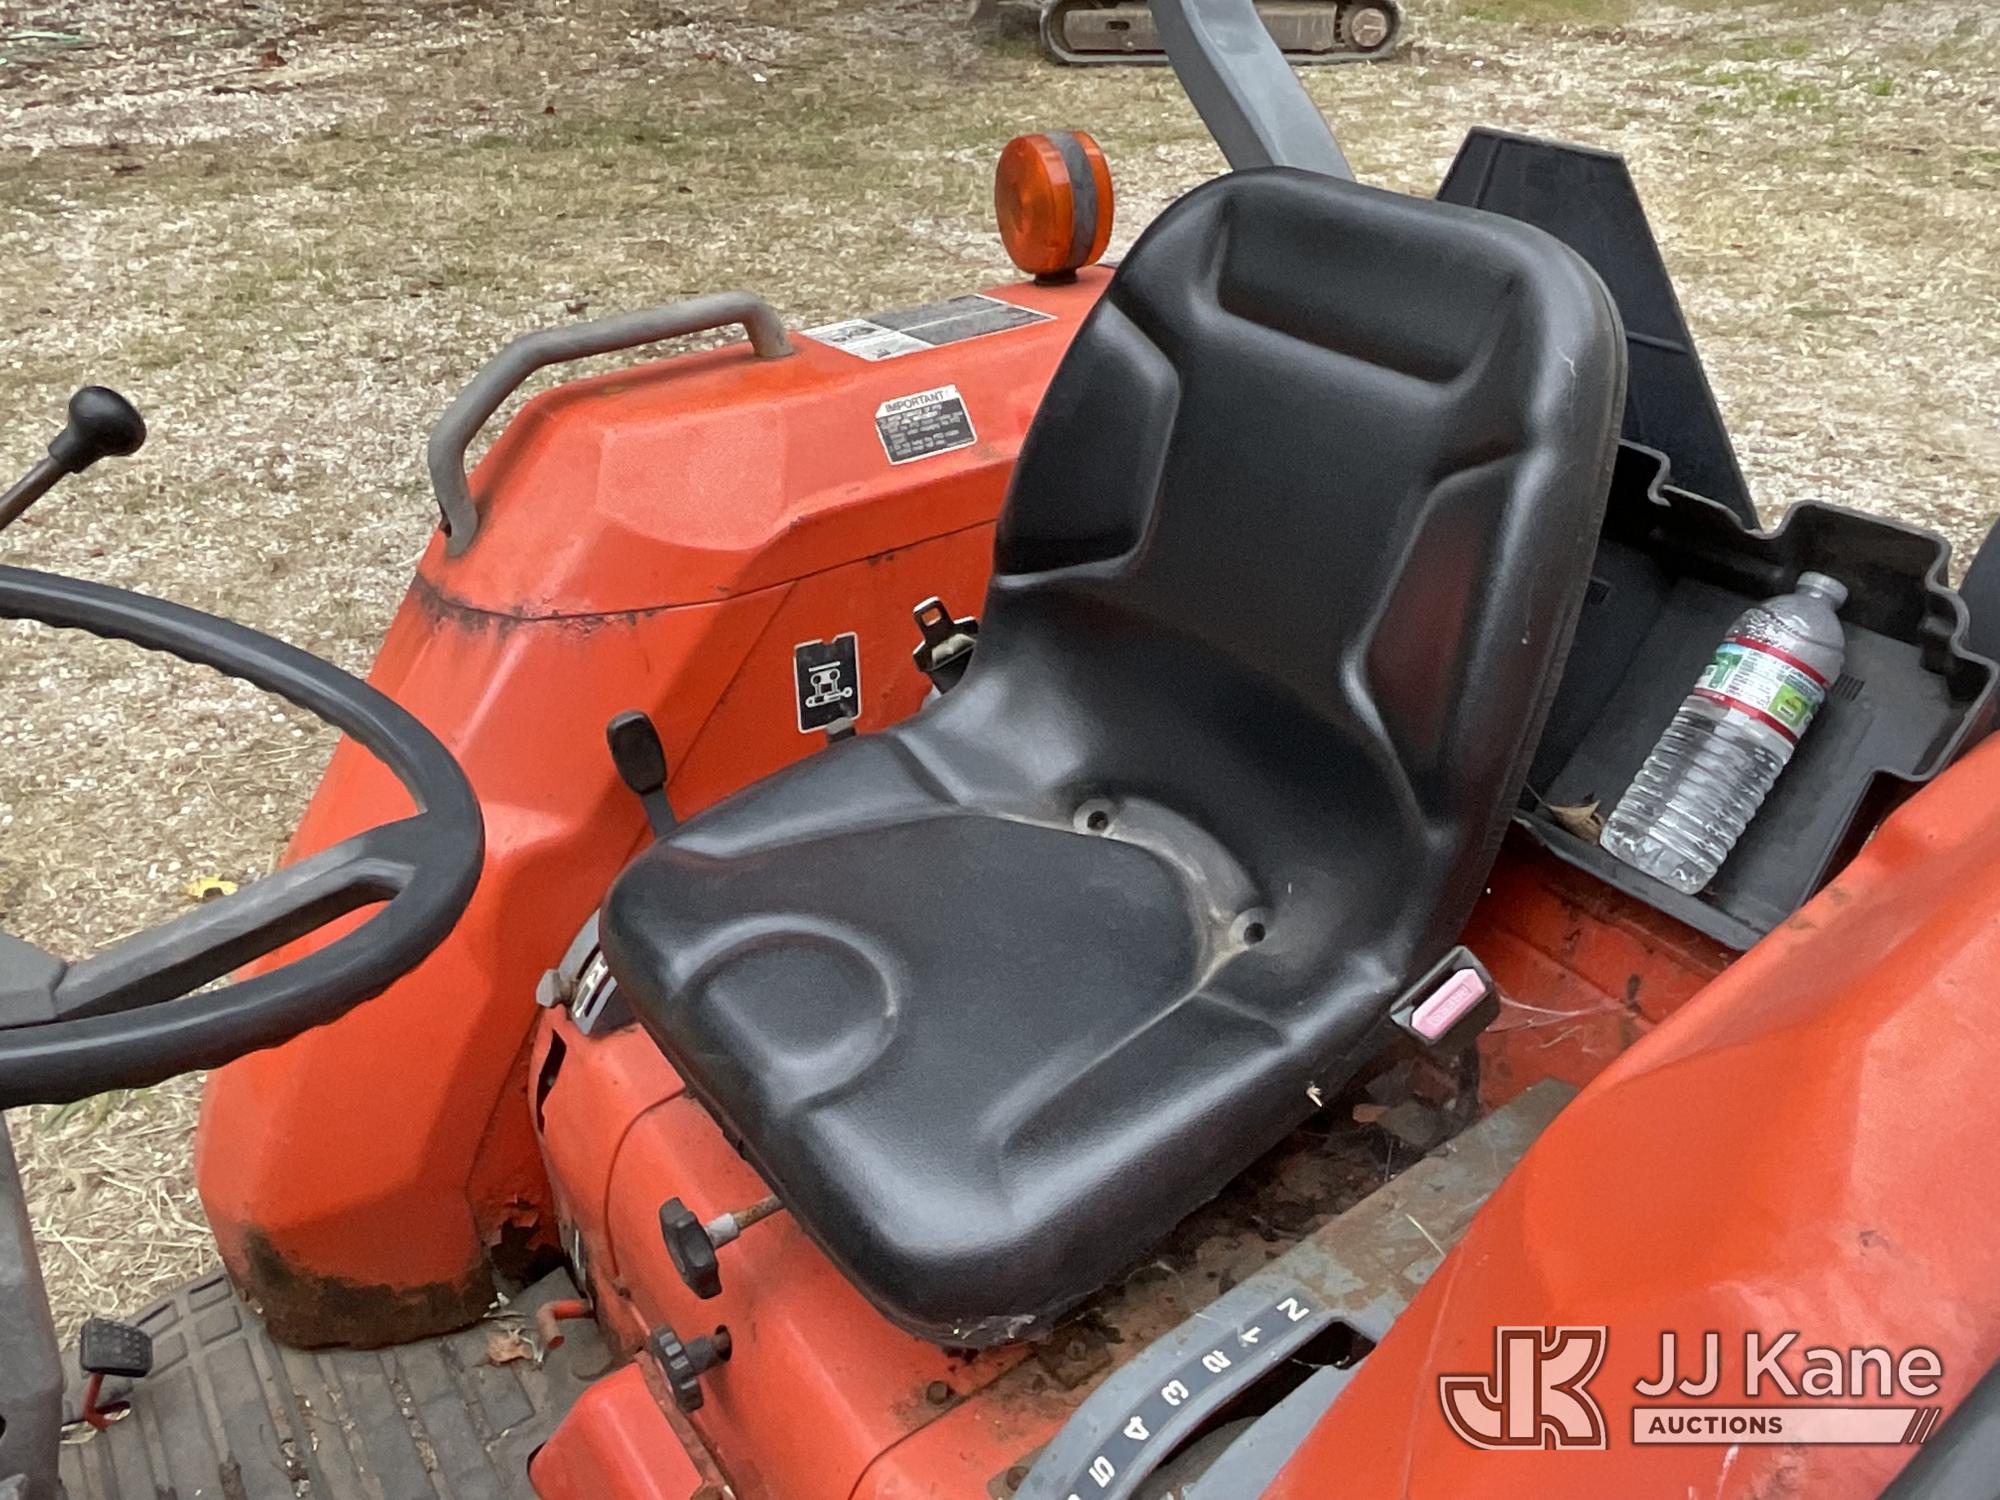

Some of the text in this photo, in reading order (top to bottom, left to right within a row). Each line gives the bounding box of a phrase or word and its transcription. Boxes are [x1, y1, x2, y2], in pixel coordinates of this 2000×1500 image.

[885, 390, 944, 412] IMPORTANT
[1276, 1297, 1310, 1322] N
[1240, 1326, 1262, 1344] 1
[1202, 1350, 1233, 1373] 2
[1161, 1379, 1189, 1406] 3
[1123, 1415, 1151, 1441] 4
[1088, 1456, 1115, 1488] 5
